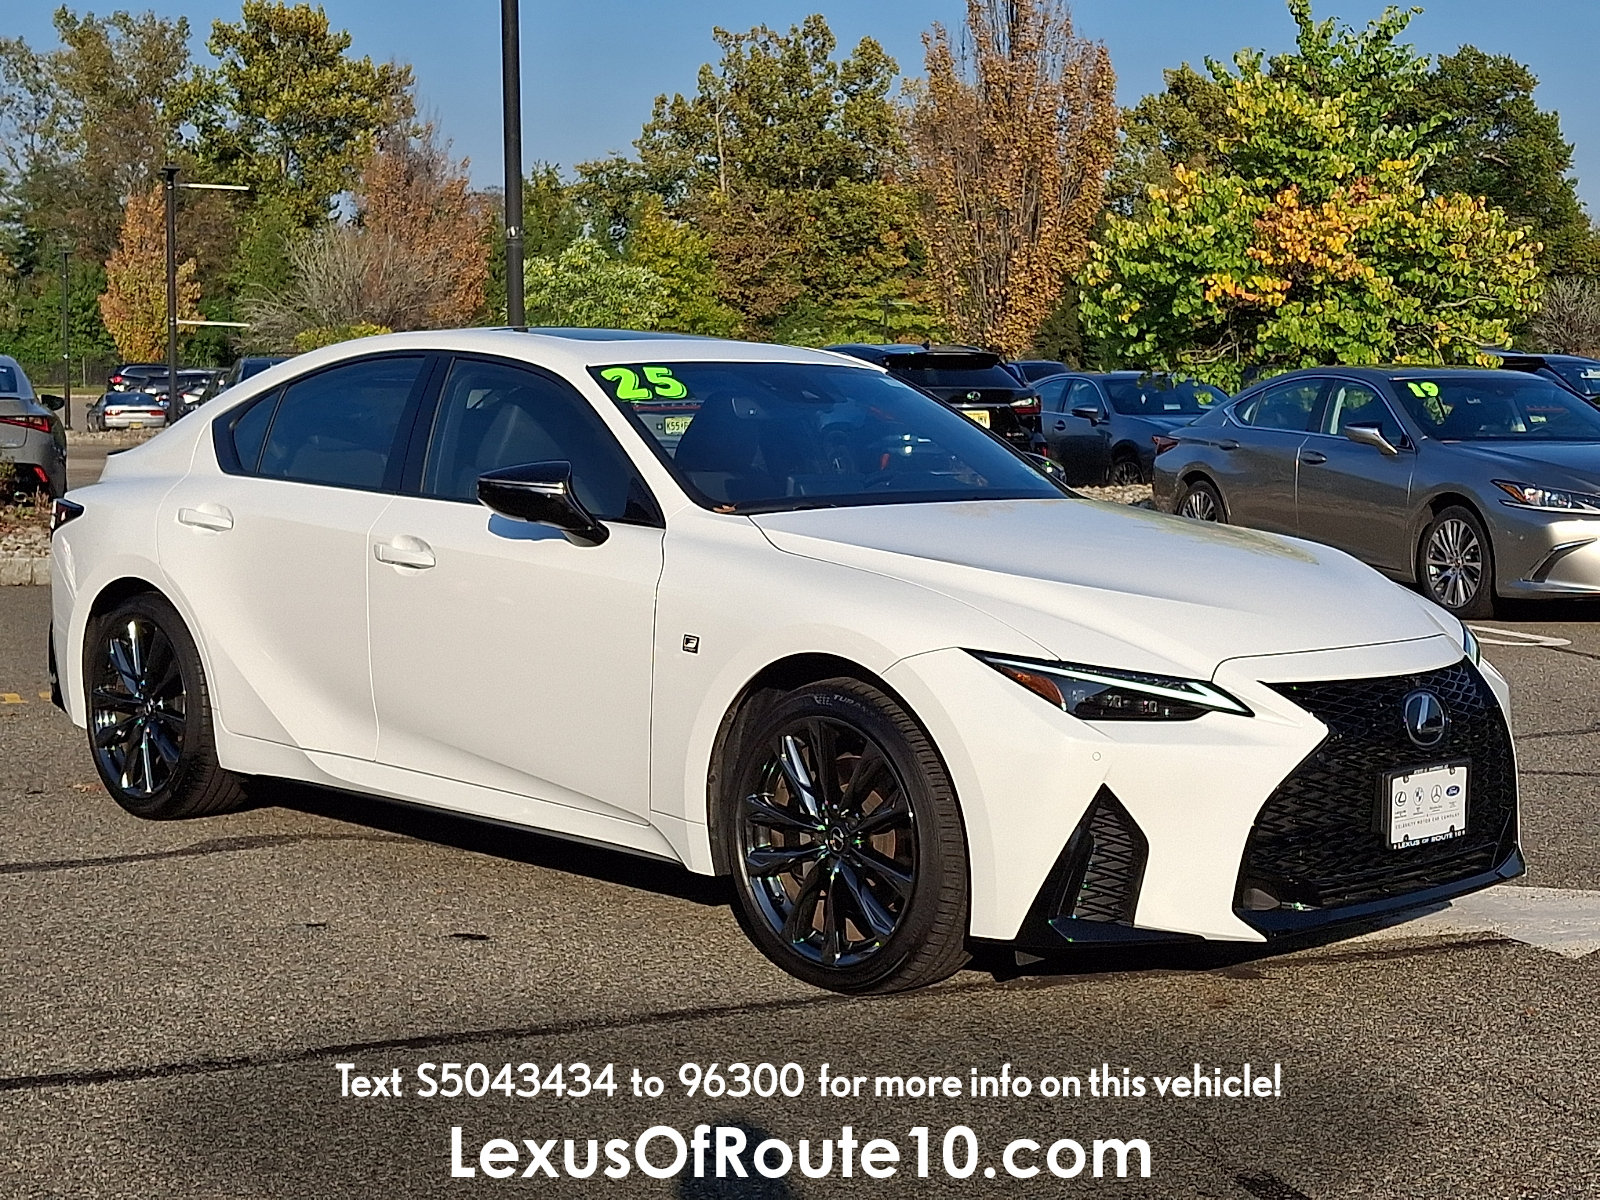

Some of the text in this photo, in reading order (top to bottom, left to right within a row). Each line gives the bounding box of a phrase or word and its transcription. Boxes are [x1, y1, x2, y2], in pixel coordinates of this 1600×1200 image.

[600, 366, 688, 400] 25
[1406, 381, 1439, 398] 19
[1397, 839, 1420, 849] LEXUS
[1431, 832, 1454, 843] ROUTE
